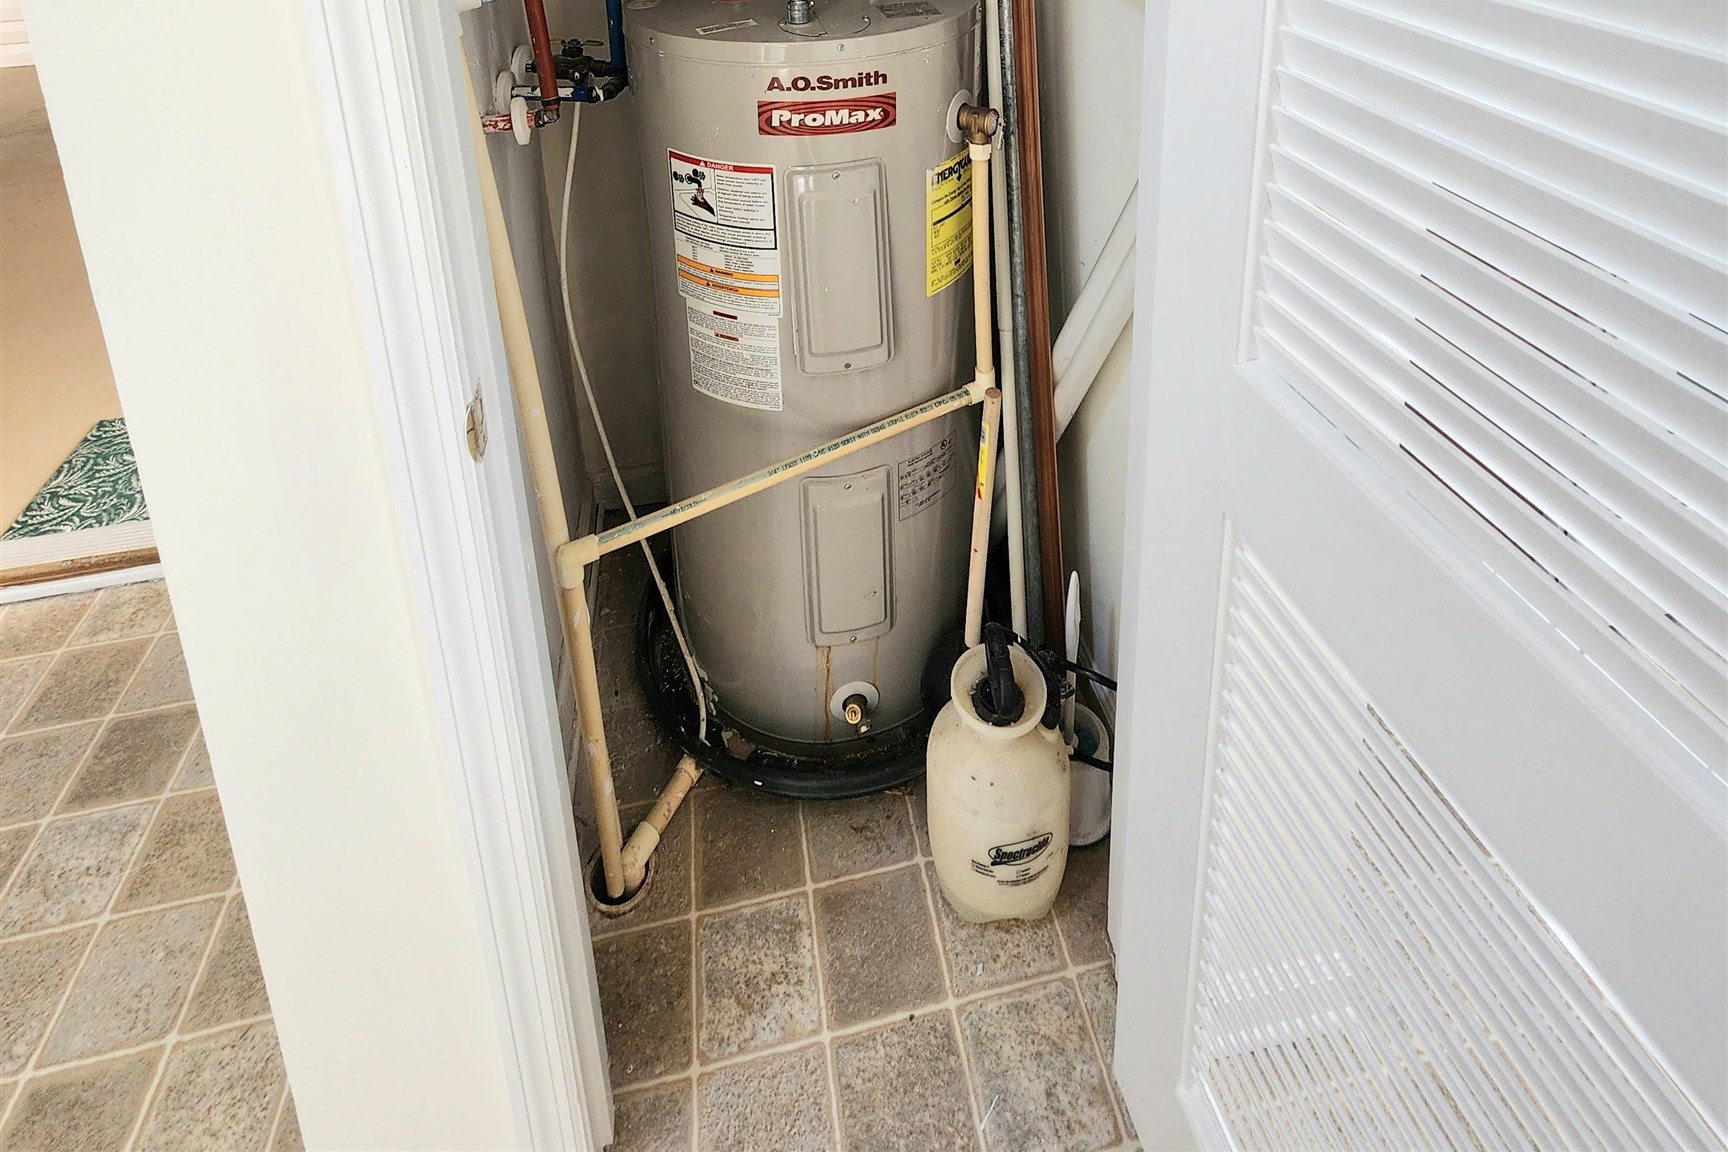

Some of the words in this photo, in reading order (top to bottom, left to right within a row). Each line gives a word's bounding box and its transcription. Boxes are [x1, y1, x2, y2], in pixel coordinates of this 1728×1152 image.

[767, 70, 888, 92] A.O.Smith
[772, 107, 882, 127] ProMax
[706, 160, 734, 171] DANGER
[714, 269, 734, 277] WARNING
[712, 283, 739, 292] ADVERTENCIA
